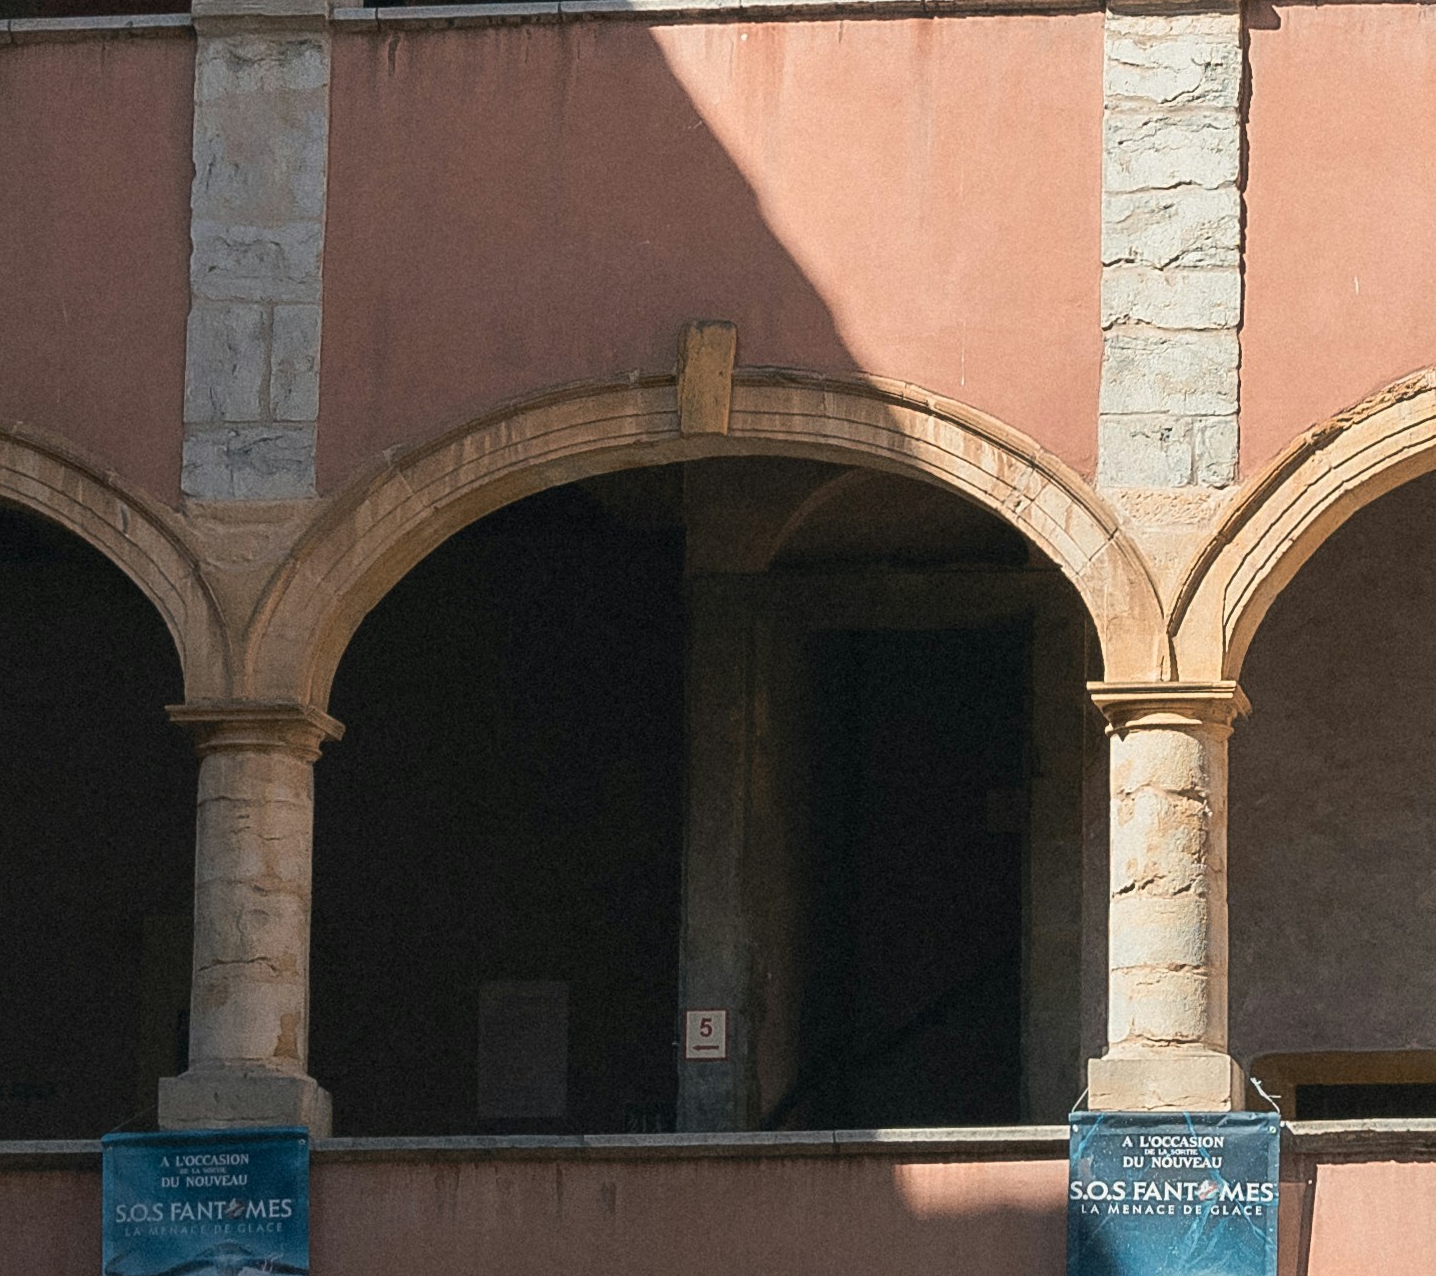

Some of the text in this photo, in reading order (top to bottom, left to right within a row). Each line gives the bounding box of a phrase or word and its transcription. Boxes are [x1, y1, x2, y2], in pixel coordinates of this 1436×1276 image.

[699, 1017, 713, 1038] 5
[1122, 1135, 1224, 1148] A L'OCCASION
[160, 1153, 249, 1167] A L'OCCASION
[1123, 1156, 1222, 1169] DU NOUVEAU
[161, 1174, 248, 1188] DU NOUVEAU
[1070, 1179, 1274, 1202] S.O.S FANTMES
[115, 1198, 292, 1223] S.O.S FANTMES
[1081, 1204, 1263, 1216] LA MENACE DE GLACE
[124, 1223, 283, 1237] LA MENACE DE GLACE
